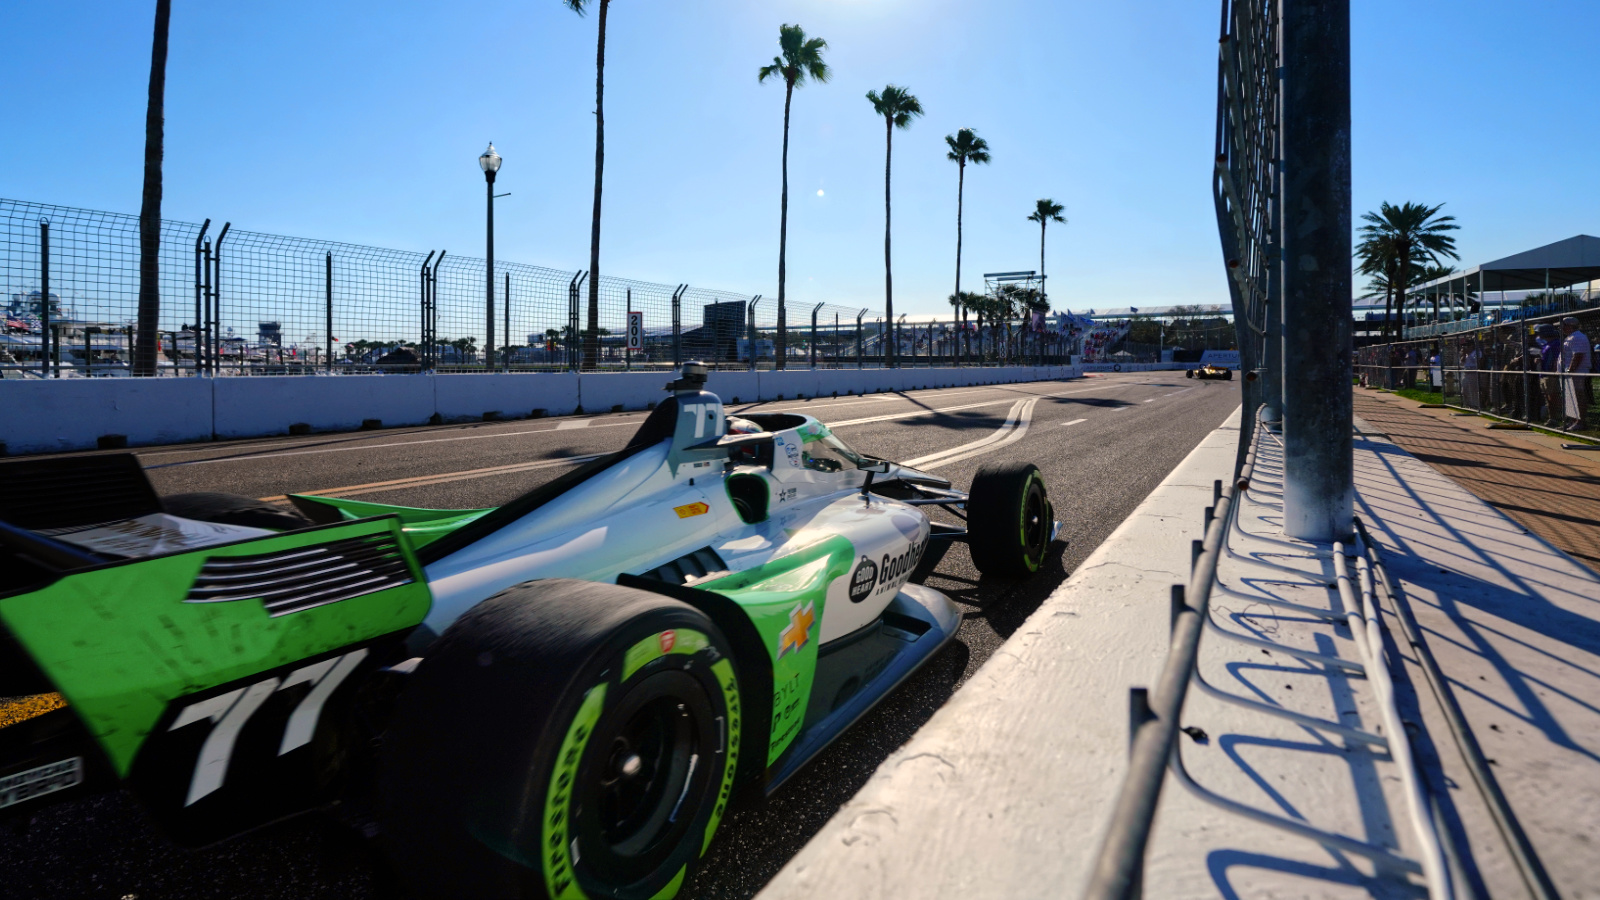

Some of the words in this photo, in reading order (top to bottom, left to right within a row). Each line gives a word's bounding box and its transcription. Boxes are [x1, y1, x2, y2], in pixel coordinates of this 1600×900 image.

[683, 403, 725, 438] 77
[855, 566, 875, 584] GOOD
[879, 532, 929, 586] Goodhe
[851, 580, 874, 597] HEART
[168, 648, 370, 808] 77
[715, 677, 739, 819] Firestone
[550, 723, 588, 896] Firestone
